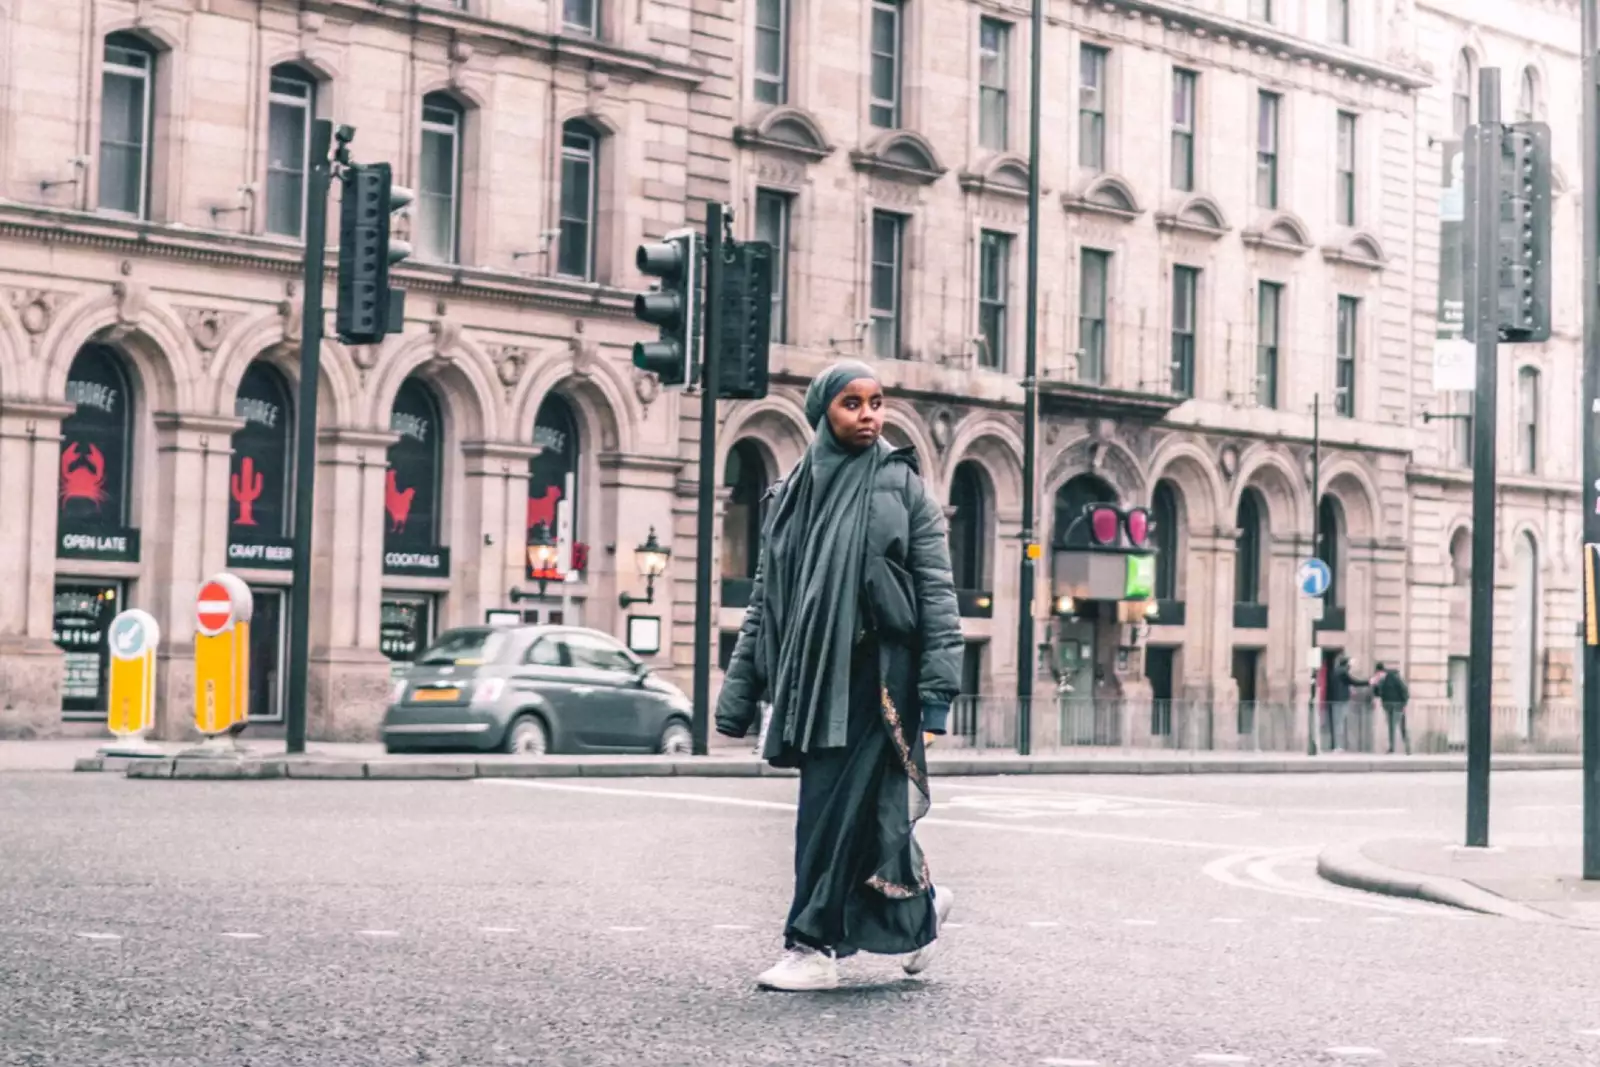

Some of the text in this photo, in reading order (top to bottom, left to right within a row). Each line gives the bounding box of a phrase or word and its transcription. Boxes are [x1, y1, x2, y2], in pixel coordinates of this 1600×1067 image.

[62, 533, 127, 552] OPEN LATE
[228, 543, 264, 559] CRAFT
[384, 552, 441, 568] COCKTAILS
